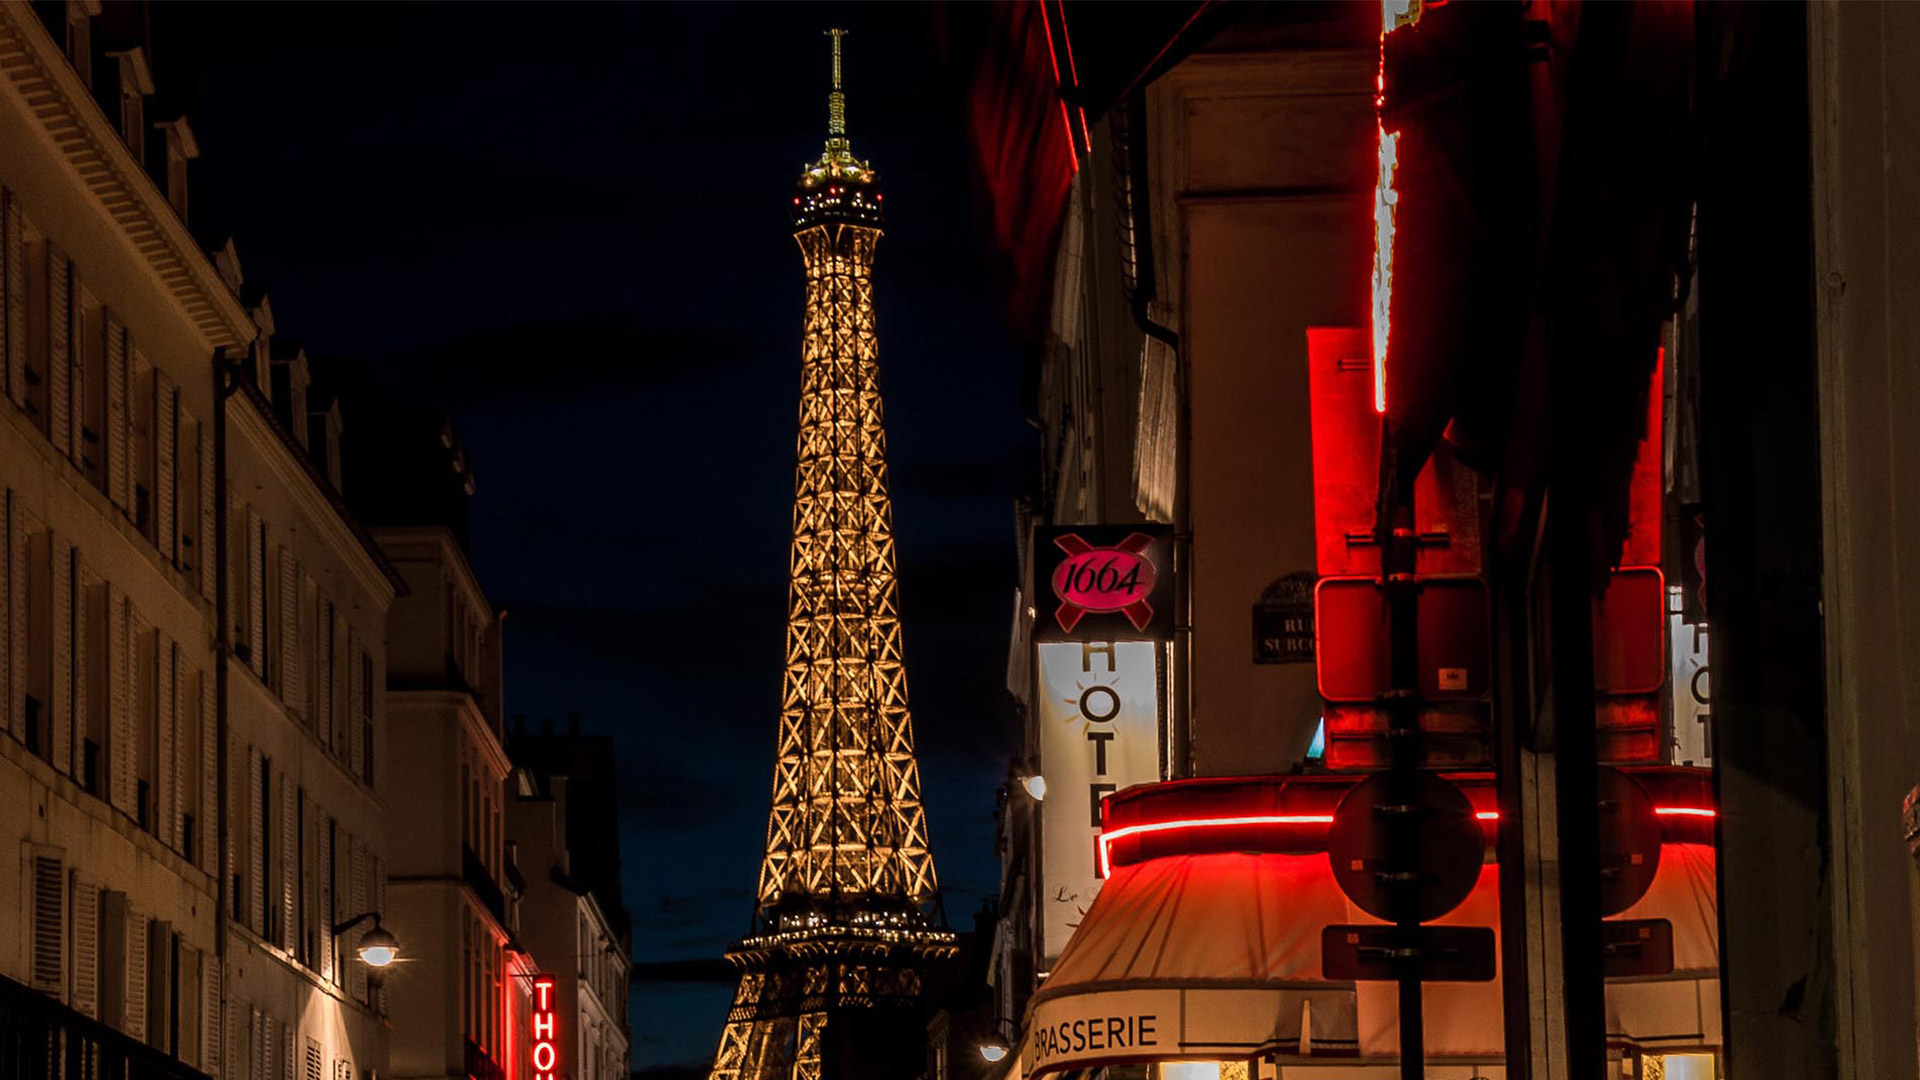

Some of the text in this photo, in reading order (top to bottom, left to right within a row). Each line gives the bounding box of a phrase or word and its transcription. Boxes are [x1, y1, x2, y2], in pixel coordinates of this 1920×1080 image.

[1063, 557, 1145, 595] 1664
[1263, 637, 1315, 652] SURCO
[1284, 618, 1315, 633] RU
[1079, 642, 1121, 879] HOTE
[533, 982, 555, 1080] THO
[1035, 1015, 1158, 1062] BRASSERIE
